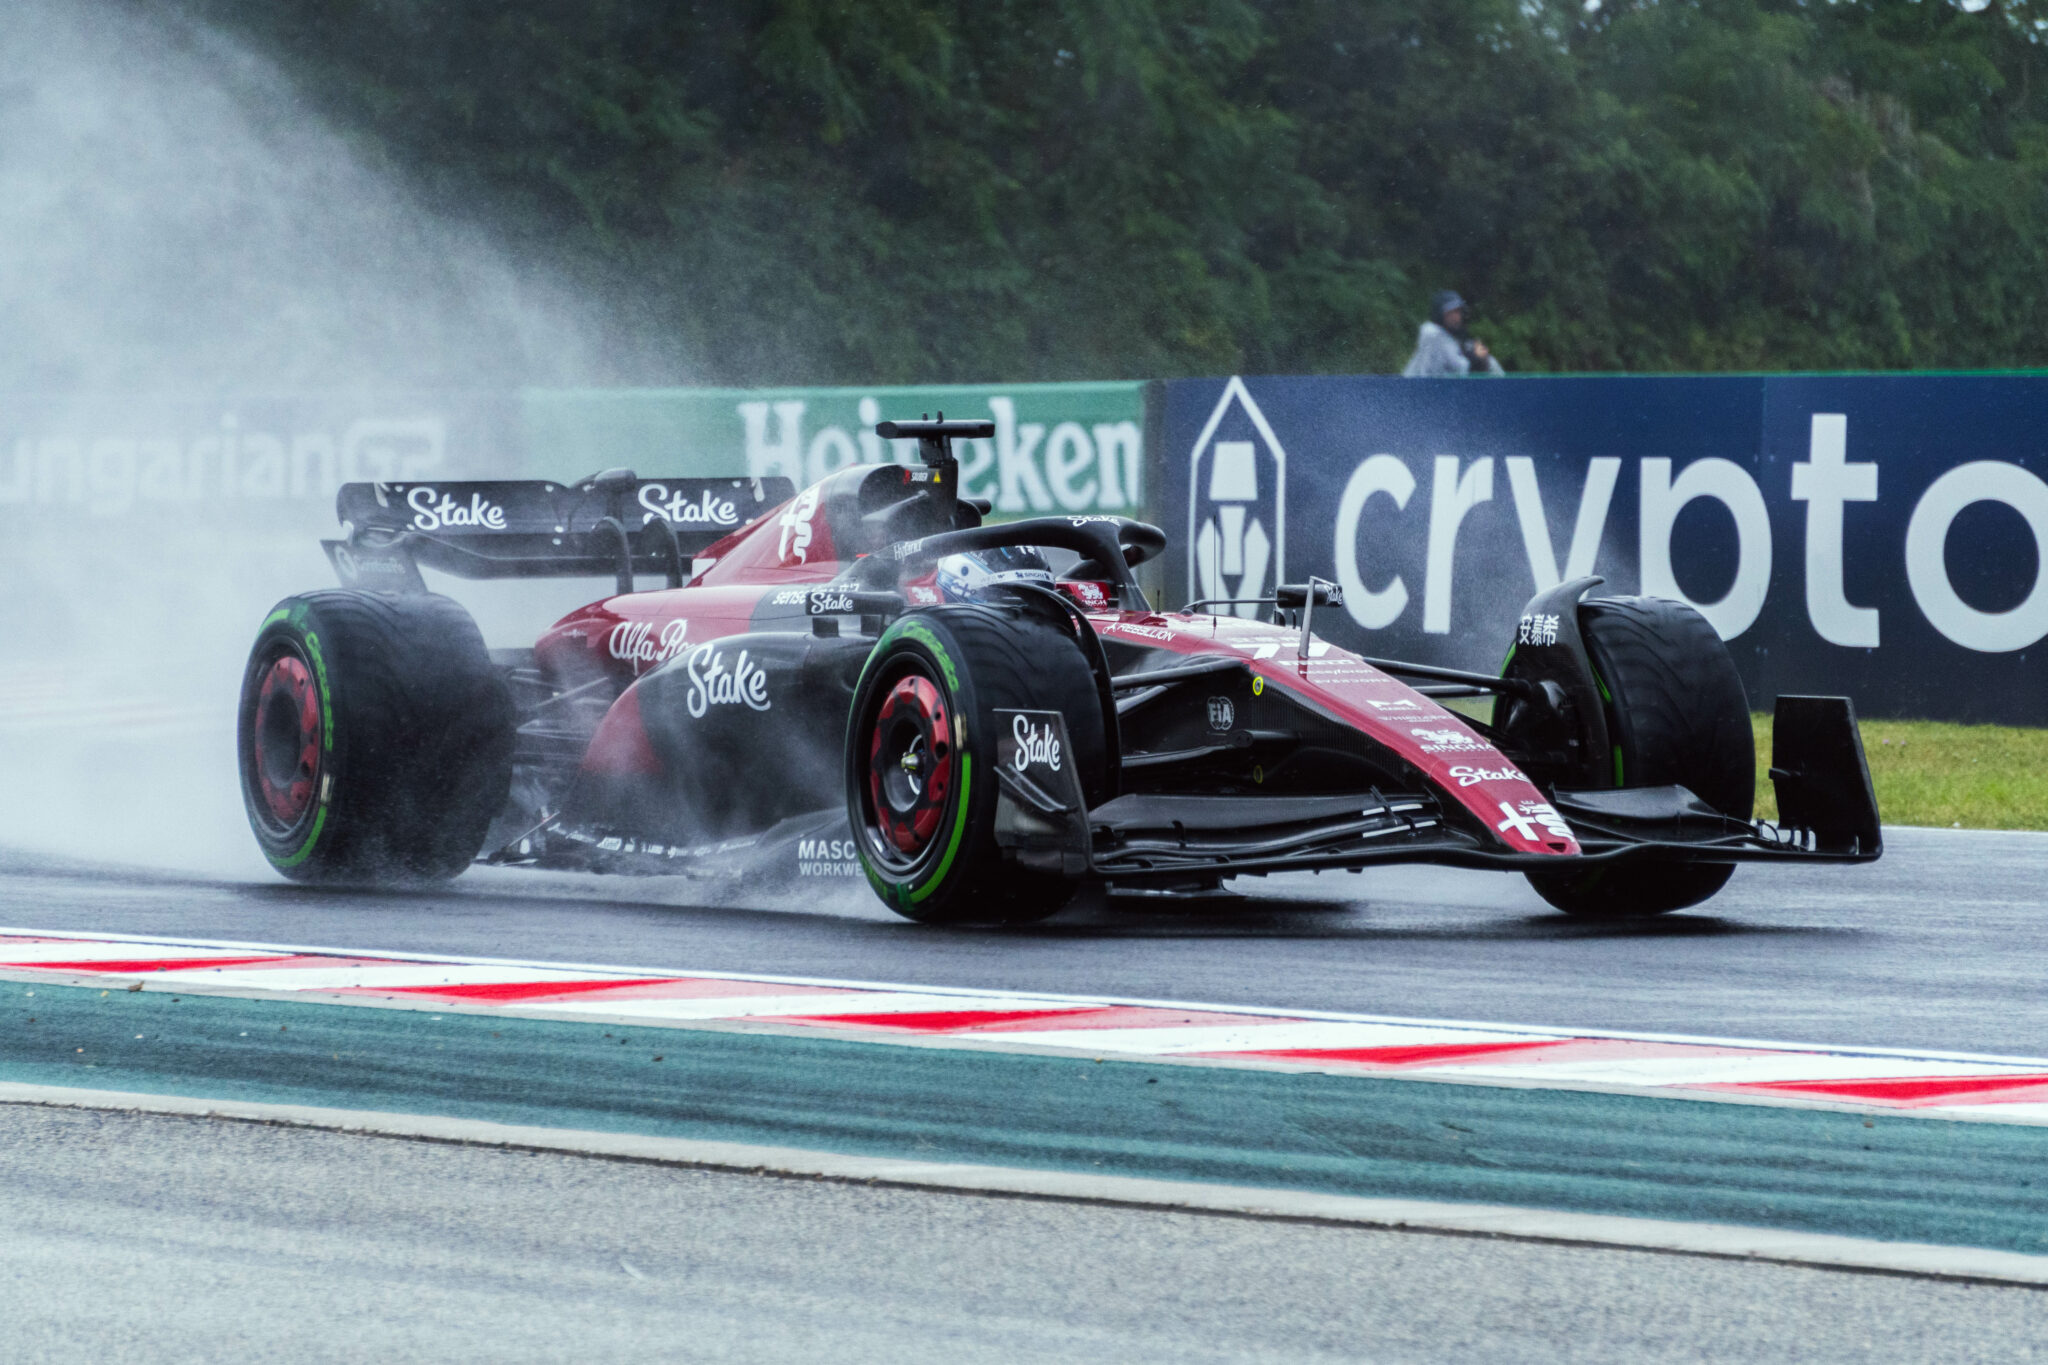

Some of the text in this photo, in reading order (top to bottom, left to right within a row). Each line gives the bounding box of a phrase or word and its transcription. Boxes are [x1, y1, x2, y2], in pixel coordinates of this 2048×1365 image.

[407, 486, 507, 531] Stake
[638, 483, 740, 526] Stake
[1333, 413, 2048, 654] crypto
[811, 591, 854, 615] Stake
[609, 621, 657, 676] Alfa
[687, 643, 771, 718] Stake
[1013, 714, 1061, 772] Stake
[1449, 765, 1532, 787] Stake
[798, 839, 857, 860] MASC
